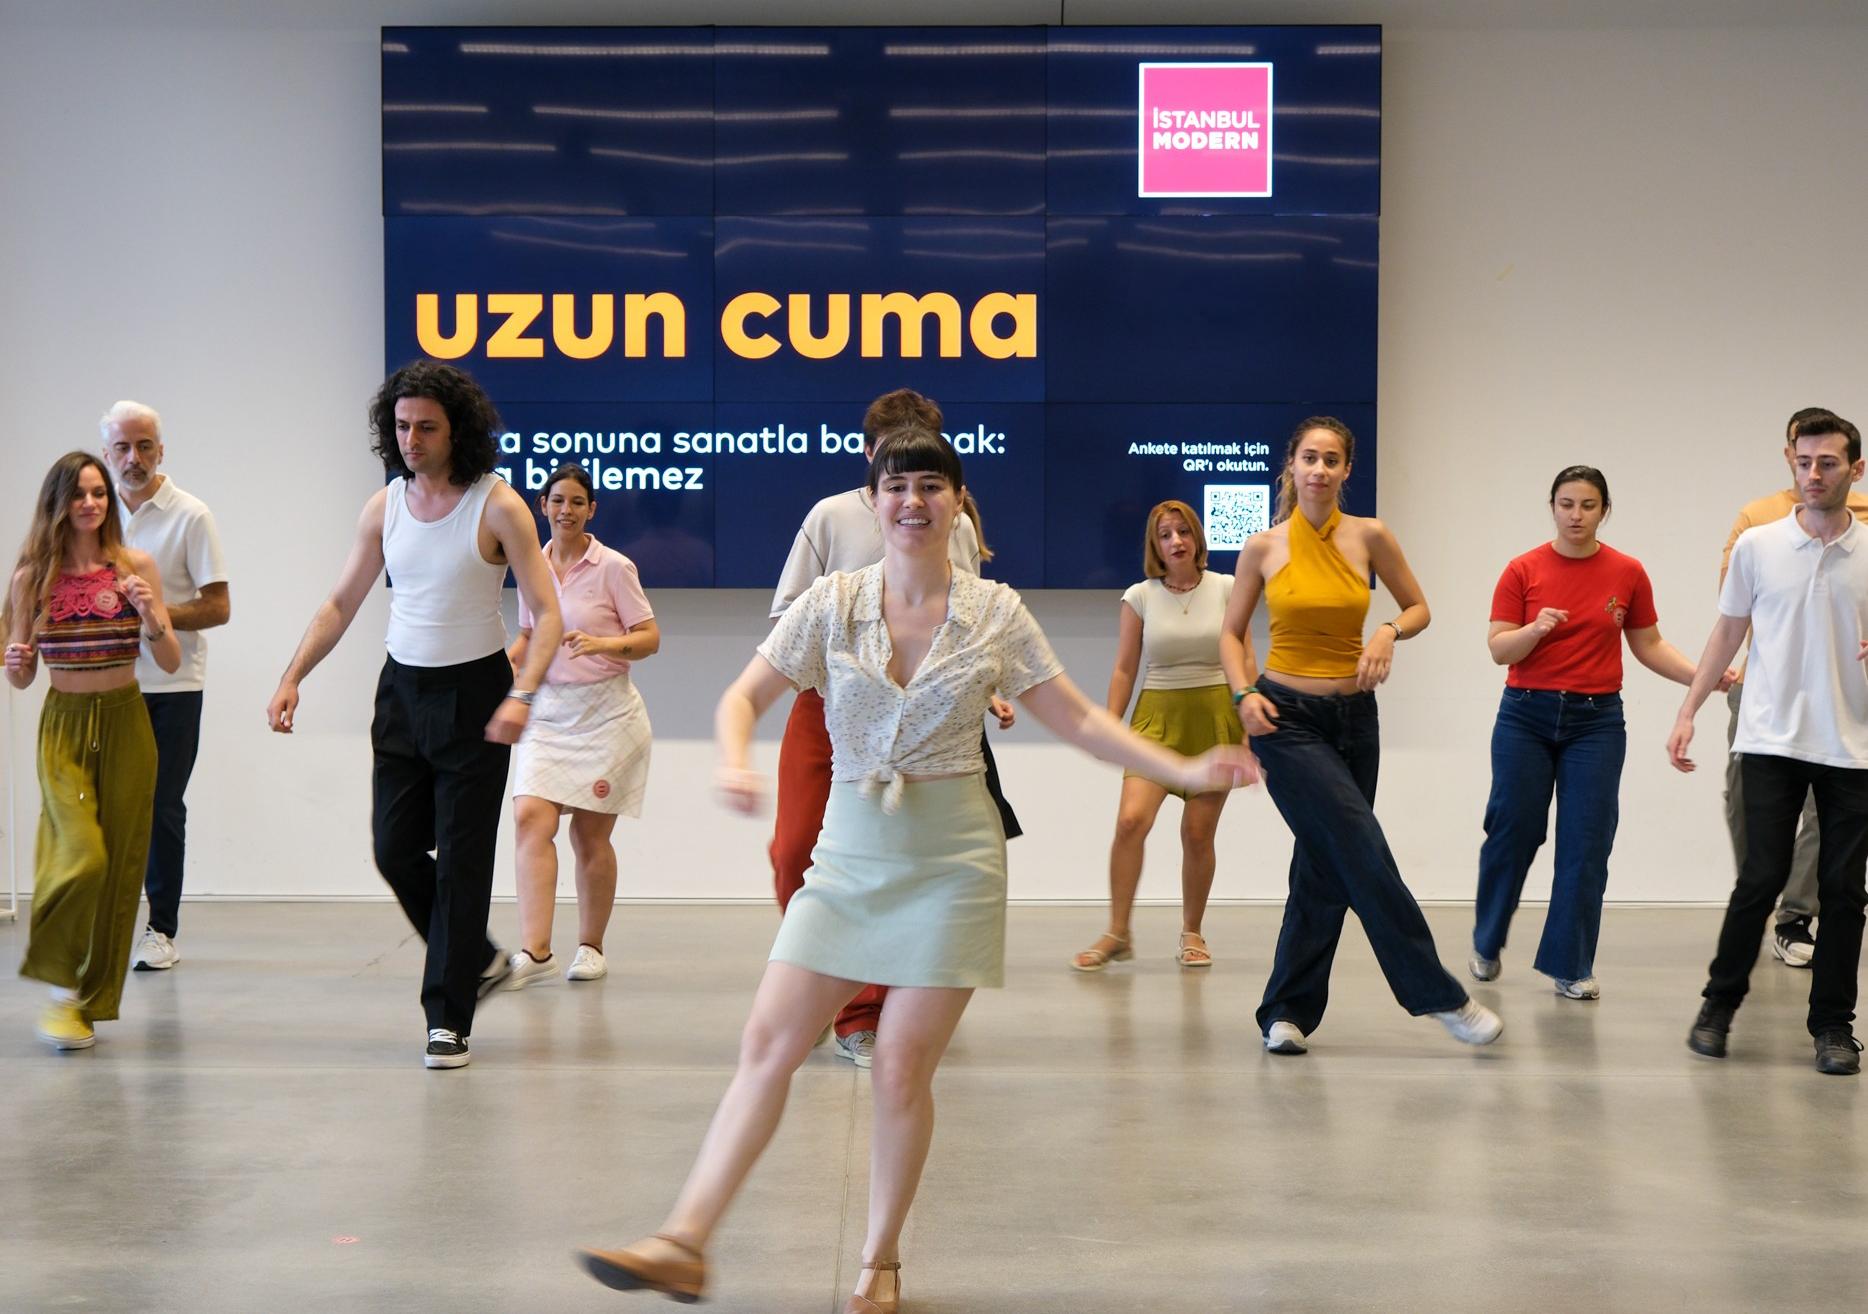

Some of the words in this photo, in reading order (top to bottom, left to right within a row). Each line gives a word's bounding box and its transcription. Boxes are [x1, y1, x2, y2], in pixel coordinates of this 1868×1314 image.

[1153, 107, 1260, 129] İSTANBUL
[1153, 131, 1259, 149] MODERN
[416, 292, 686, 360] uzun
[720, 291, 1037, 360] cuma
[532, 432, 661, 454] sonuna
[672, 423, 808, 454] sanatla
[1128, 441, 1179, 455] Ankete
[1181, 441, 1241, 455] katılmak
[1244, 441, 1270, 457] için
[525, 458, 704, 490] biilemez
[1216, 458, 1270, 472] okutun.
